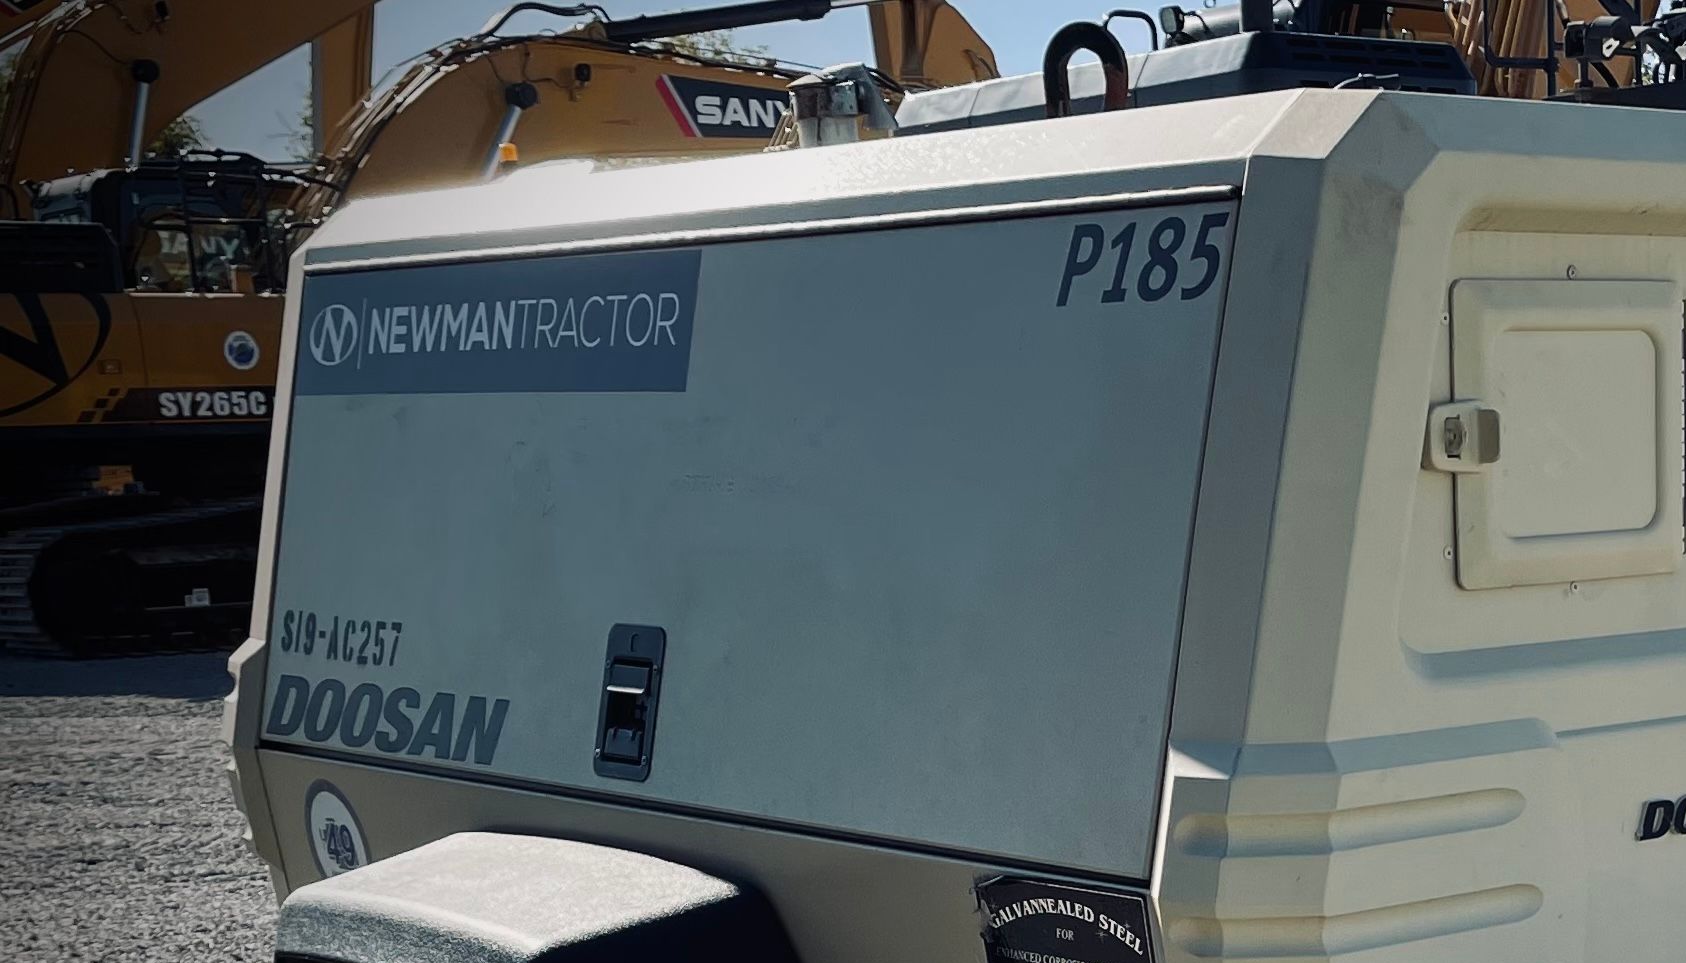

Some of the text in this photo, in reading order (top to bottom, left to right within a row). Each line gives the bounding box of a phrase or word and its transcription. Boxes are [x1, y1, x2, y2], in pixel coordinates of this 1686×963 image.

[1056, 212, 1231, 308] P185
[158, 390, 268, 417] SY265C
[280, 609, 403, 667] S19-AC257
[266, 674, 510, 765] DOOSAN
[991, 898, 1144, 956] GALVANNEALED STEEL
[1056, 927, 1075, 941] FOR
